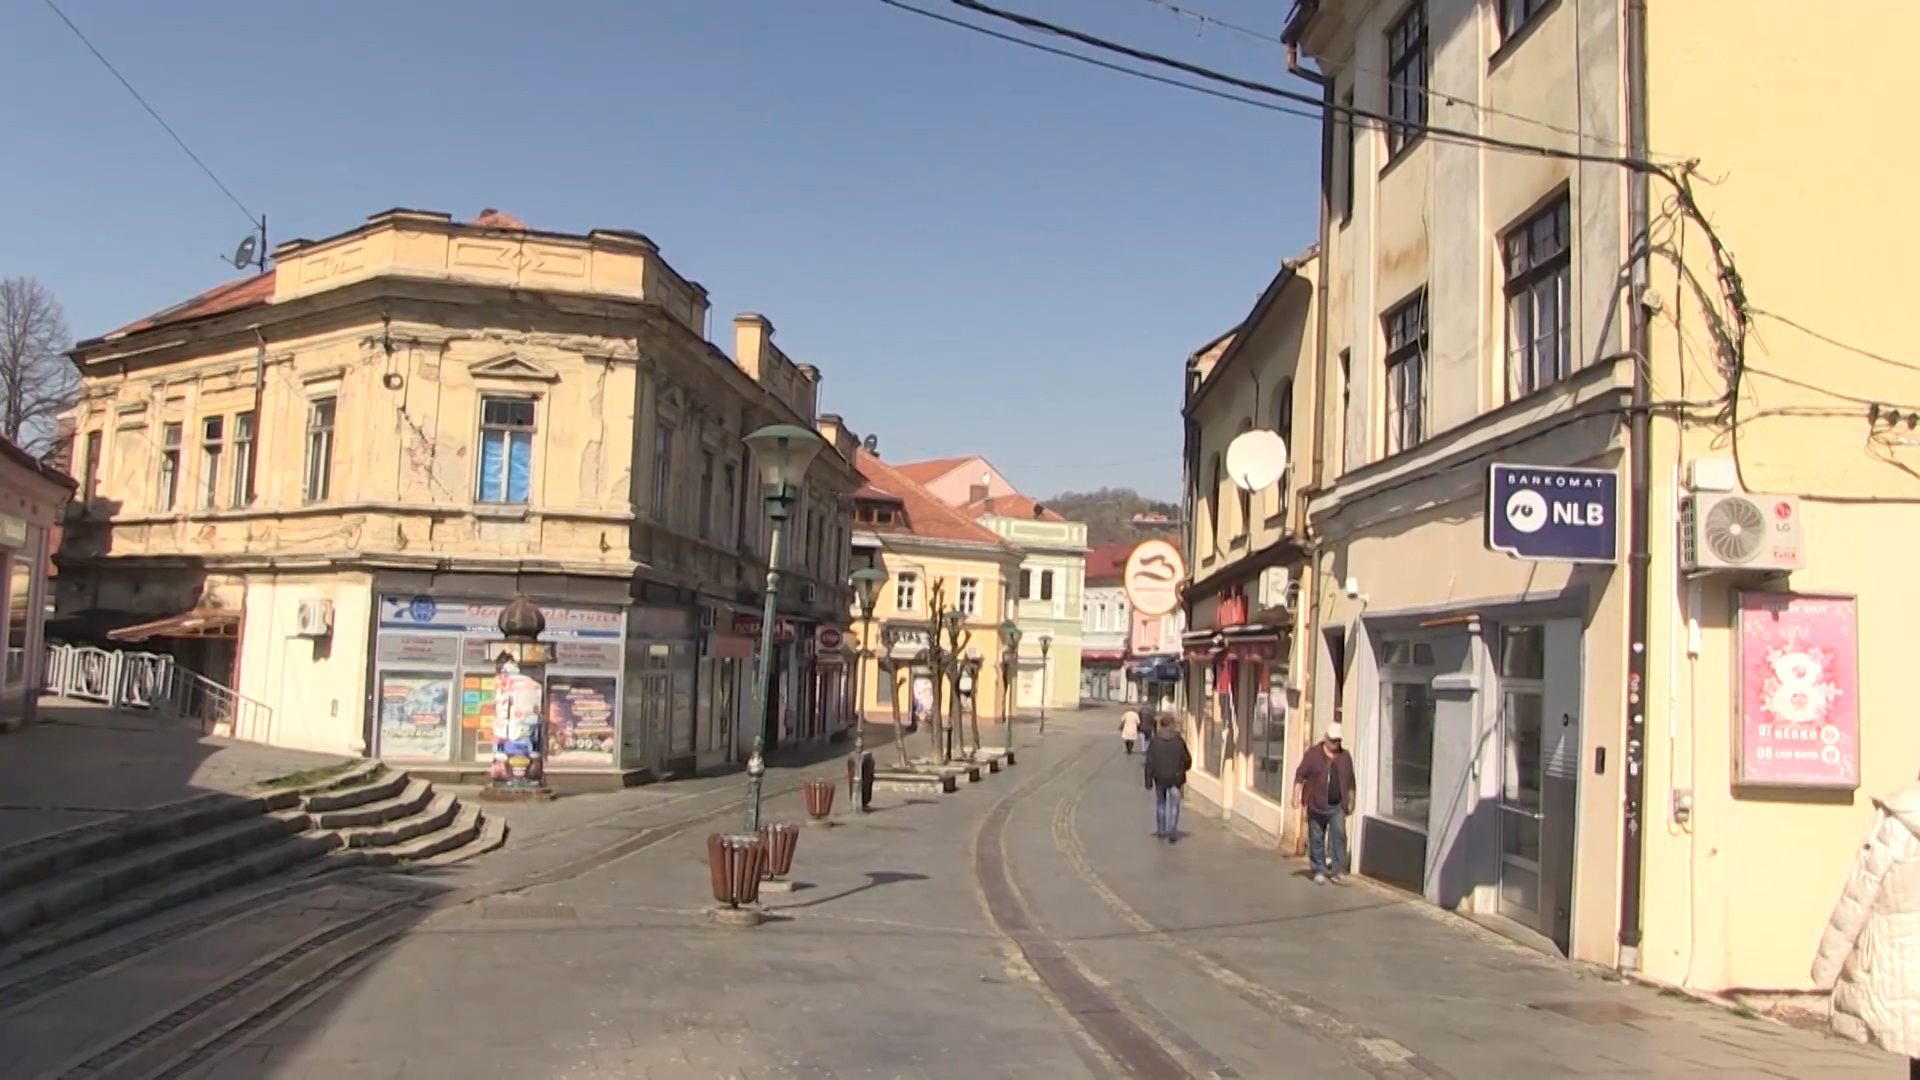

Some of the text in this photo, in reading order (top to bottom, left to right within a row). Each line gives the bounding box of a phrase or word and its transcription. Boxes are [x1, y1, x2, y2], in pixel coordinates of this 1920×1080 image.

[1508, 473, 1602, 488] BANKOMAT
[1553, 501, 1604, 526] NLB
[1776, 523, 1791, 532] LG
